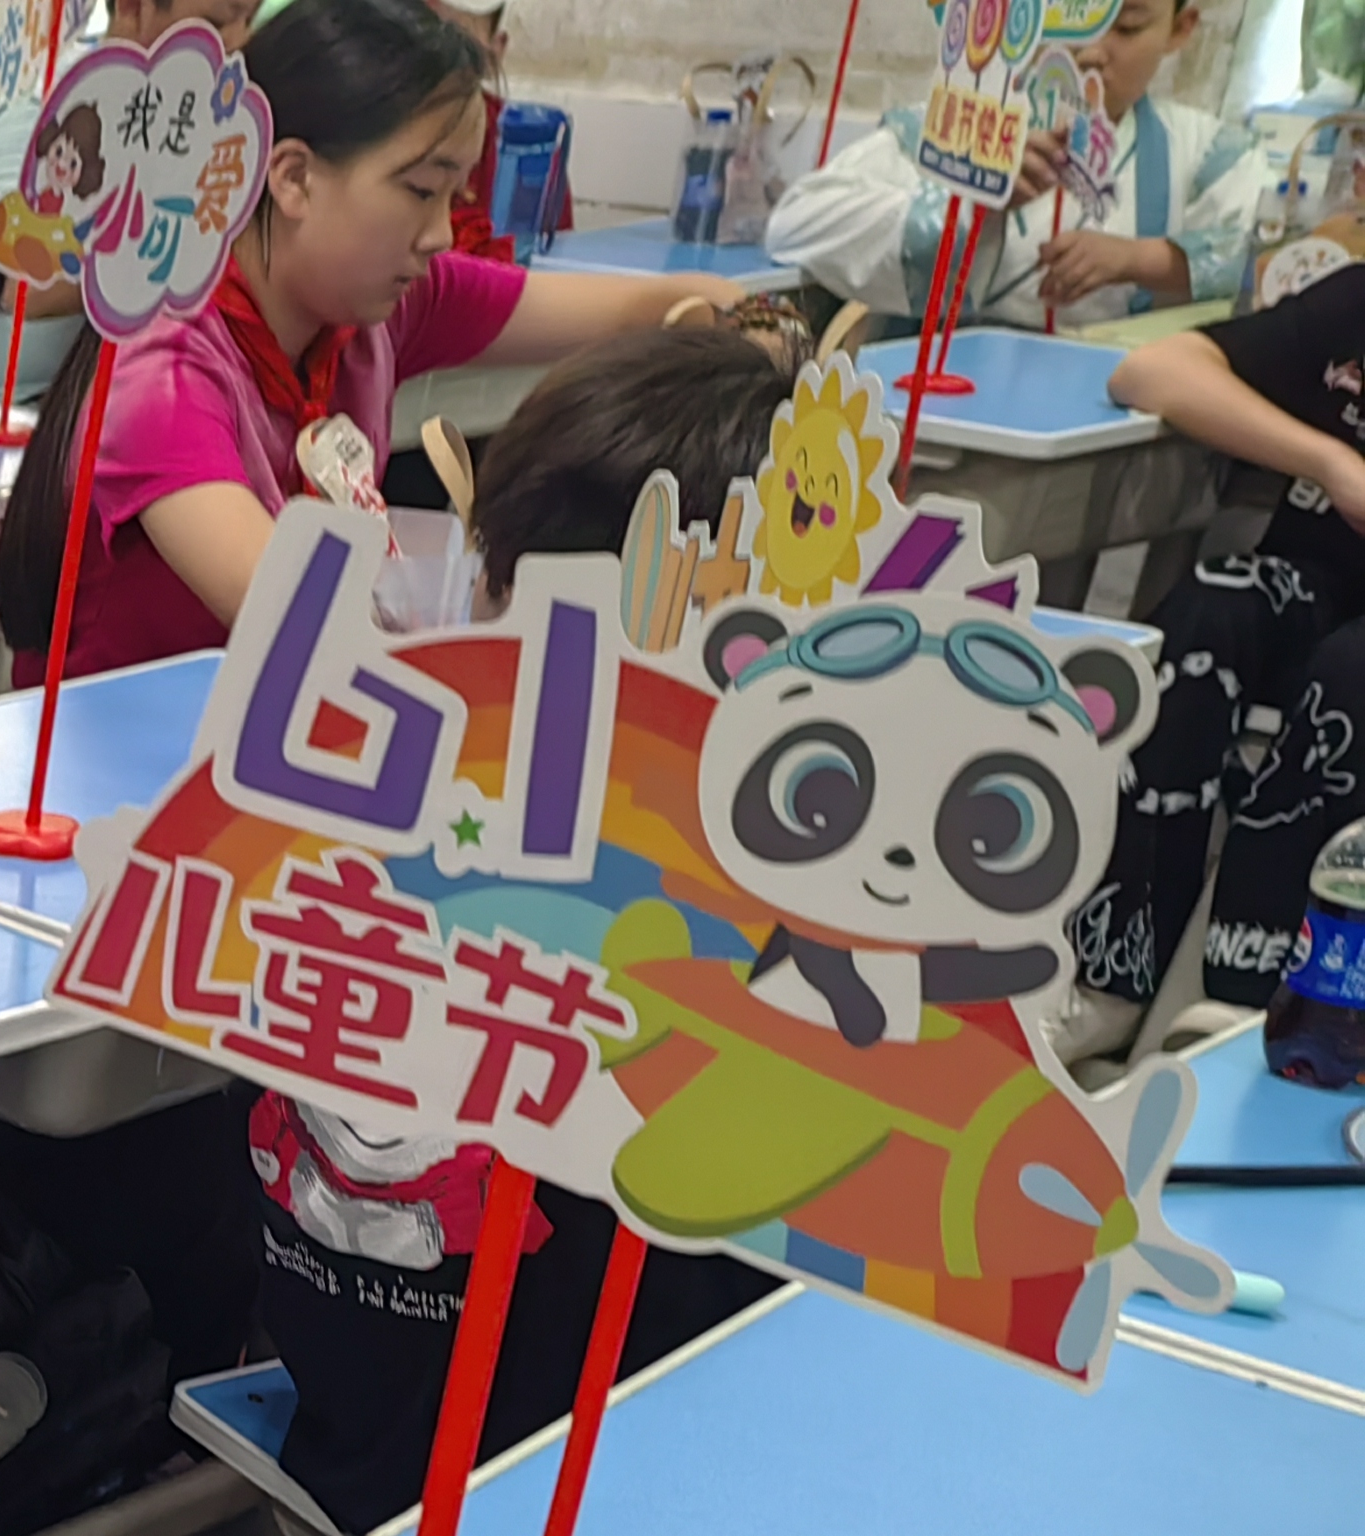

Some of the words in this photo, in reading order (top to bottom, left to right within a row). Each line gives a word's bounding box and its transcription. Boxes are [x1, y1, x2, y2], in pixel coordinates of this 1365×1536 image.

[92, 133, 247, 284] 小可爱
[117, 81, 196, 155] 我是
[233, 528, 597, 857] 61
[80, 849, 627, 1128] 儿童节
